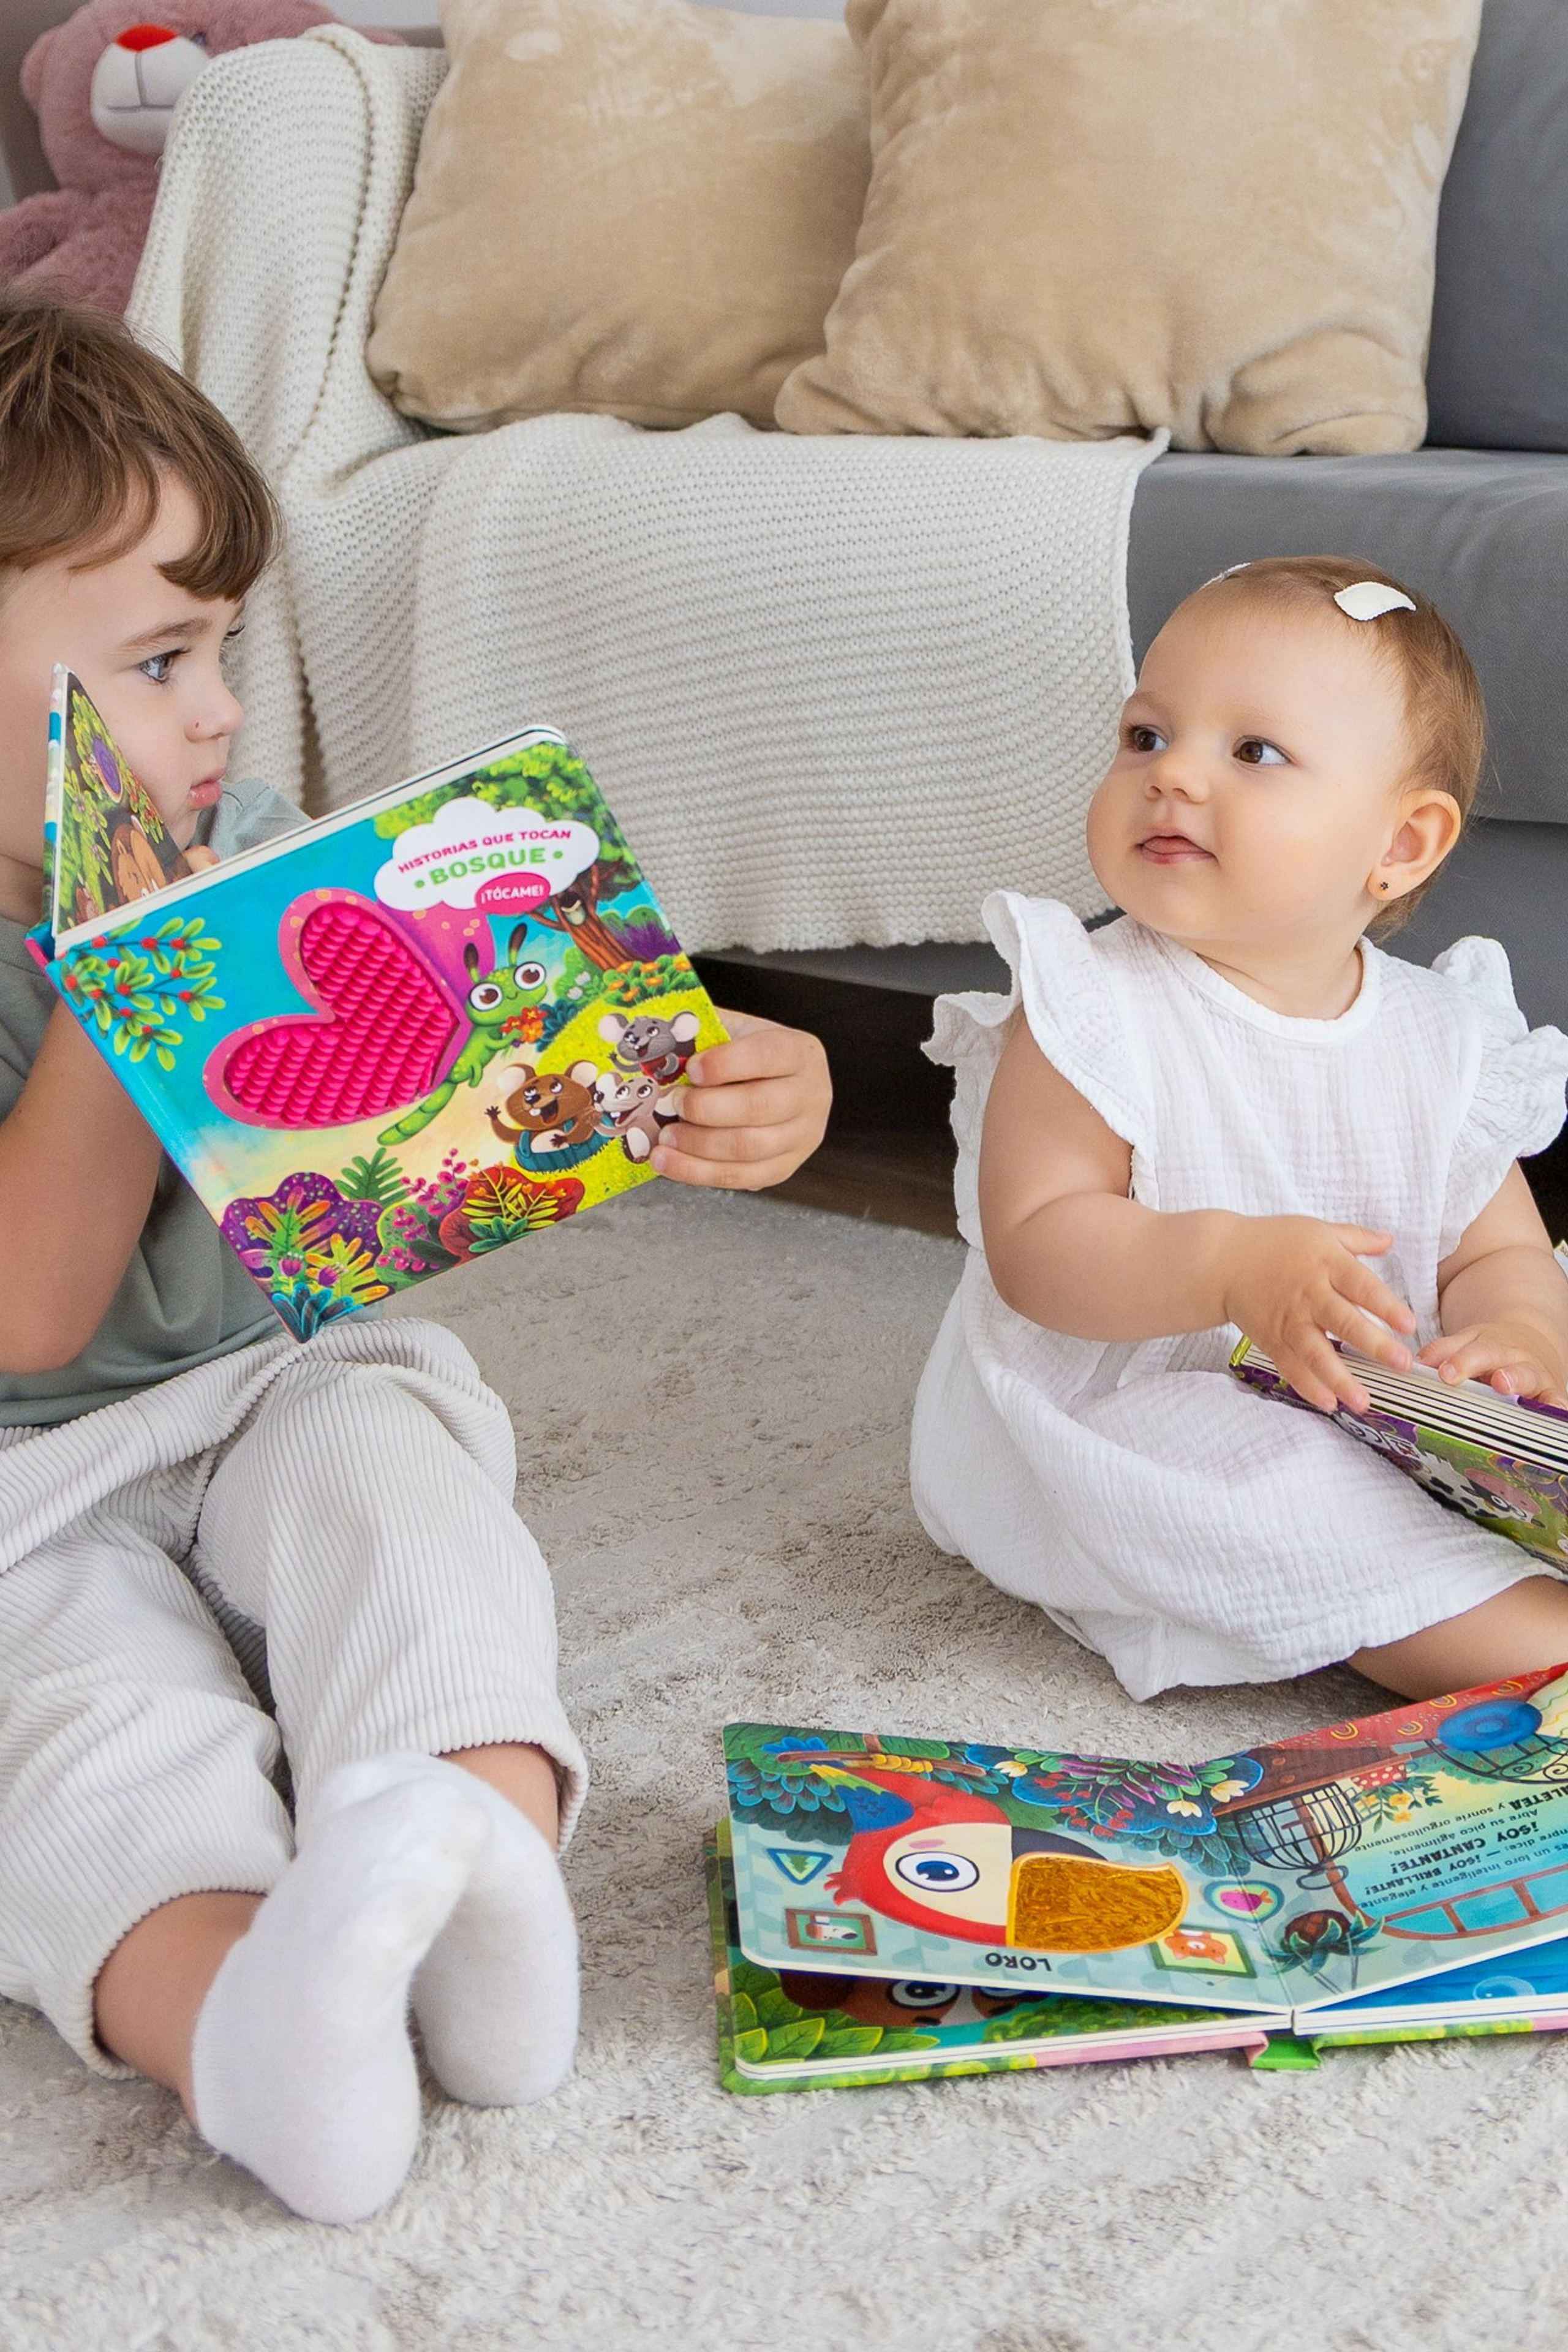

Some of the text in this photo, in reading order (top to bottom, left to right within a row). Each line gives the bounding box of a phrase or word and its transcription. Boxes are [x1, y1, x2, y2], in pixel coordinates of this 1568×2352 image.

[398, 830, 571, 873] HISTORIAS QUE TOCAN
[429, 848, 546, 885] BOSQUE
[481, 884, 544, 904] ¡TÓCAME!
[1490, 1818, 1506, 1827] su
[1509, 1809, 1538, 1822] Abre
[1354, 1819, 1451, 1852] orgullosamente
[1460, 1822, 1486, 1836] pico
[1390, 1821, 1539, 1874] ¡SOY CANTANTE!
[1534, 1848, 1551, 1856] un
[1449, 1854, 1481, 1871] ¡SOY
[1504, 1854, 1531, 1866] loro
[1365, 1867, 1442, 1895] BRILLANTE!
[1432, 1863, 1502, 1888] inteligente
[1420, 1883, 1428, 1893] y
[985, 1952, 1052, 1972] LORO
